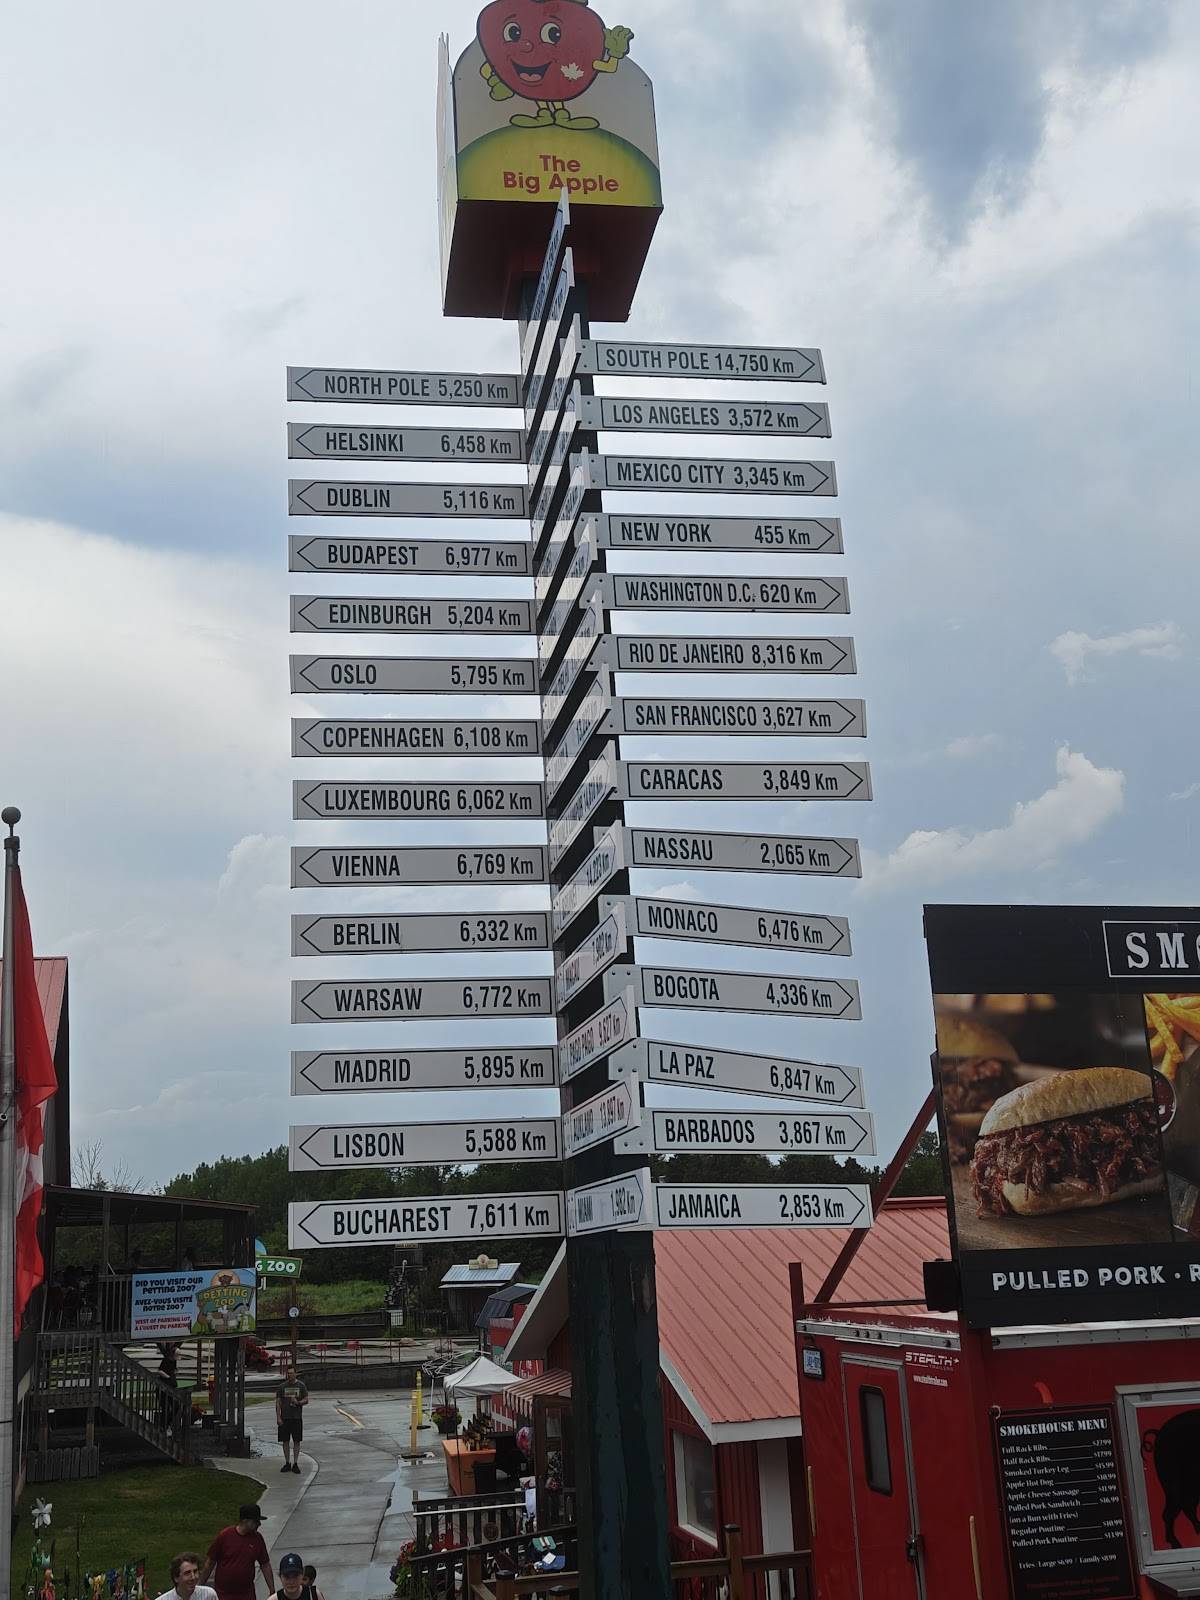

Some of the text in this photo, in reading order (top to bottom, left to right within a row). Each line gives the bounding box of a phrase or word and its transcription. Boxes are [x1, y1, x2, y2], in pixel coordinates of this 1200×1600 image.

[539, 154, 581, 172] The
[503, 171, 619, 194] Big Apple
[606, 349, 794, 376] SOUTH POLE 14,750 Km
[325, 376, 508, 399] NORTH POLE 5,250 Km
[613, 405, 798, 431] LOS ANGELES 3,572 Km
[327, 432, 511, 455] HELSINKI 6,458 Km
[618, 463, 804, 488] MEXICO CITY 3,345 Km
[328, 488, 514, 511] DUBLIN 5,116 Km
[621, 522, 810, 544] NEW YORK 455 Km
[328, 545, 517, 568] BUDAPEST 6,977 Km
[625, 582, 722, 601] WASHINGTON
[760, 584, 789, 603] 620
[795, 588, 816, 603] Km
[330, 604, 520, 628] EDINBURGH 5,204 Km
[630, 644, 822, 667] RIO DE JANEIRO 8,316 Km
[331, 664, 524, 688] OSLO 5,795 Km
[636, 705, 831, 730] SAN FRANCISCO 3,627 Km
[324, 727, 528, 750] COPENHAGEN 6,108 Km
[641, 769, 838, 793] CARACAS 3,849 Km
[325, 790, 532, 812] LUXEMBOURG 6,062 Km
[645, 837, 830, 869] NASSAU 2,065 Km
[332, 854, 533, 878] VIENNA 6,769 Km
[334, 920, 537, 945] BERLIN 6,332 Km
[648, 905, 822, 945] MONACO 6,476 Km
[1125, 932, 1200, 970] SM
[335, 986, 541, 1011] WARSAW 6,772 Km
[654, 975, 832, 1008] BOGOTA 4,336 Km
[335, 1056, 543, 1083] MADRID 5,895 Km
[660, 1050, 834, 1095] LA PAZ 6,847 Km
[334, 1128, 546, 1158] LISBON 5,588 Km
[665, 1119, 845, 1147] BARBADOS 3,867 Km
[669, 1194, 844, 1221] JAMAICA 2,853 Km
[334, 1203, 549, 1236] BUCHAREST 7,611 Km
[267, 1260, 296, 1273] ZOO
[992, 1265, 1166, 1291] PULLED PORK
[204, 1288, 247, 1299] PETTING
[215, 1298, 235, 1307] ZOO
[905, 1351, 953, 1367] STEALTH
[1000, 1419, 1108, 1436] SMOKEHOUSE MENU
[1004, 1469, 1032, 1477] Smoked
[1033, 1467, 1056, 1476] Turkey
[1006, 1481, 1025, 1489] Apple
[1007, 1488, 1080, 1501] Apple Cheese Sausage
[1008, 1500, 1080, 1512] Pulled Pork Sandwich
[1011, 1525, 1065, 1535] Regular Poutine
[1012, 1539, 1034, 1548] Pulled
[1052, 1535, 1078, 1544] Poutine
